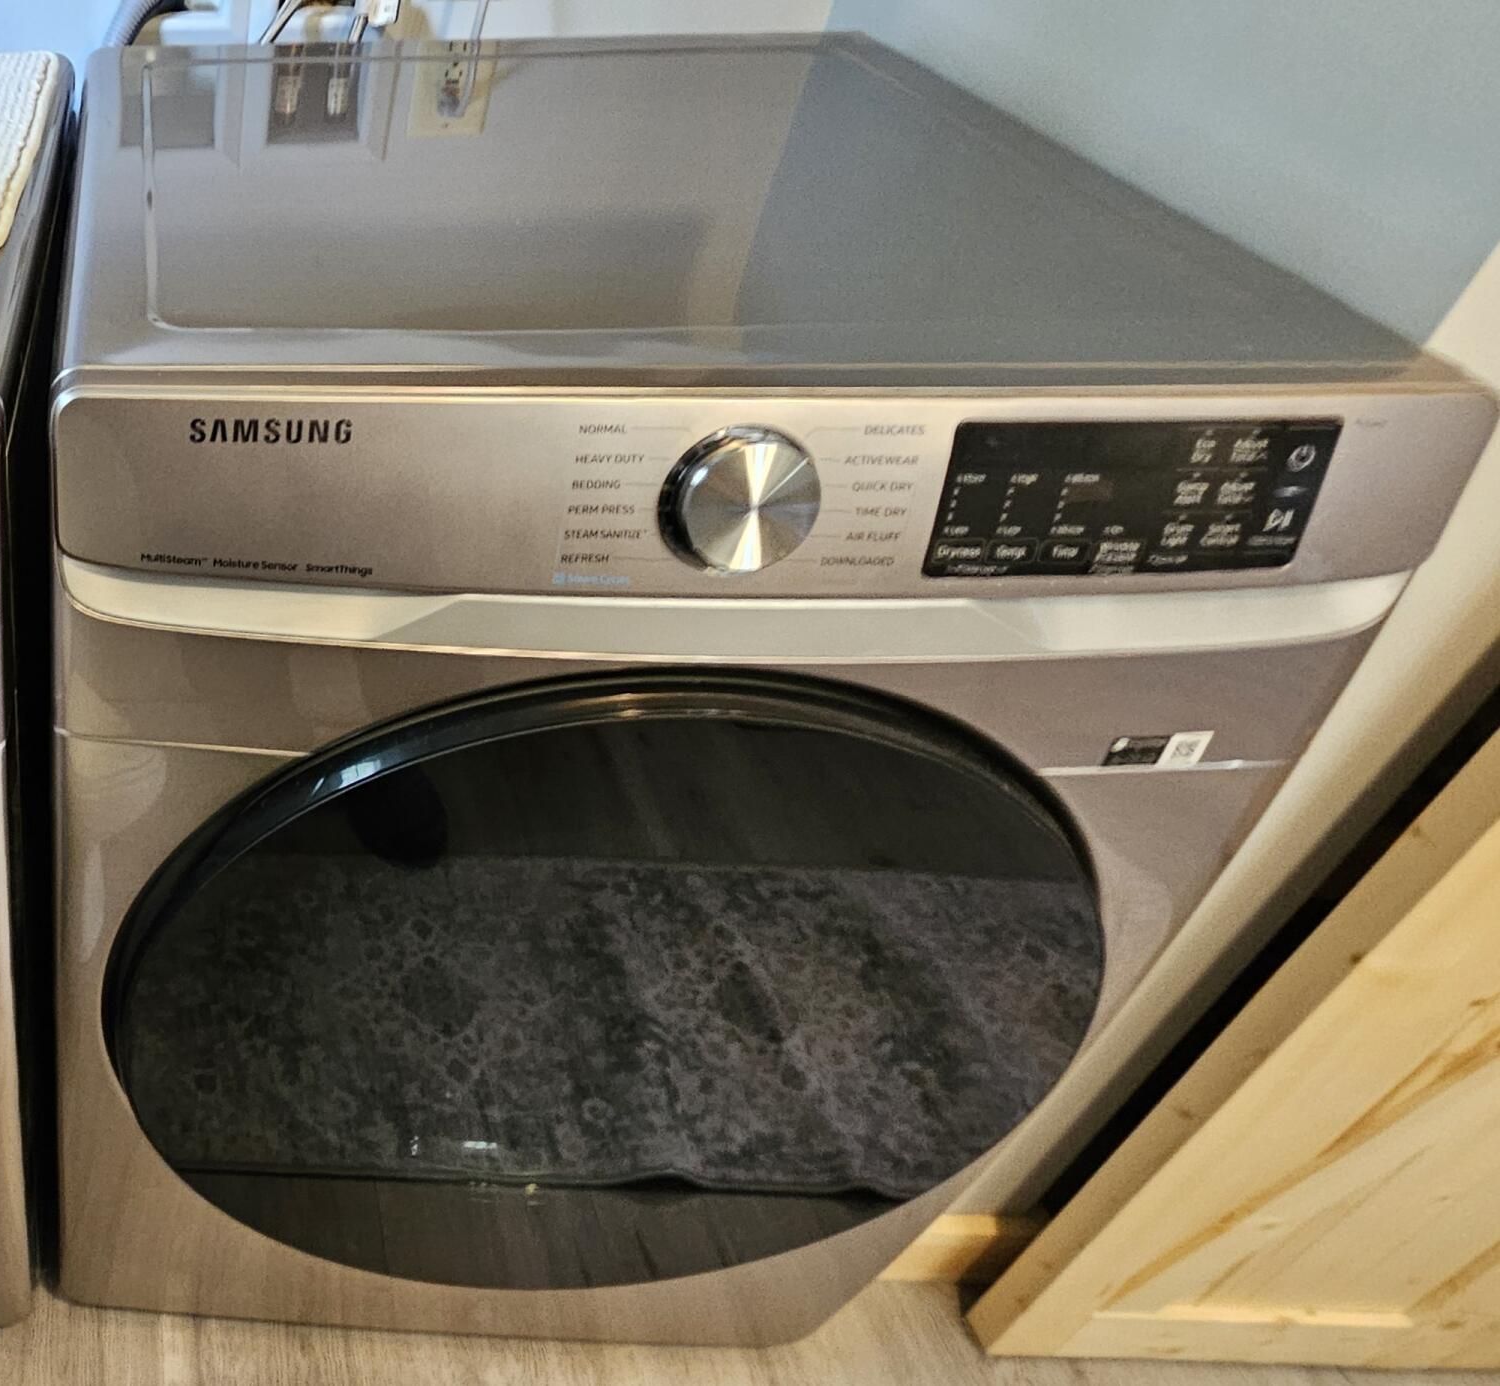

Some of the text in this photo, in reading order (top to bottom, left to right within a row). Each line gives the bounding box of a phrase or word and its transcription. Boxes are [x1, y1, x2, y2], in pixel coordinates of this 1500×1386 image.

[189, 418, 353, 444] SAMSUNG
[579, 424, 627, 434] NORMAL
[864, 424, 925, 435] DELICATES
[575, 454, 644, 464] HEAVY DUTY
[844, 455, 920, 465] ACTIVEWEAR
[572, 479, 621, 489] BEDDING
[851, 481, 914, 492] QUICK DRY
[568, 504, 635, 514] PERM PRESS
[856, 506, 908, 517] TIME DRY
[564, 529, 598, 540] STEAM
[846, 532, 902, 541] AIR FLUFF
[561, 553, 610, 564] REFRESH
[820, 556, 894, 566] DOWNLOADED
[213, 556, 259, 570] Moisture
[261, 559, 298, 571] Sensor
[305, 562, 373, 578] SmartThings
